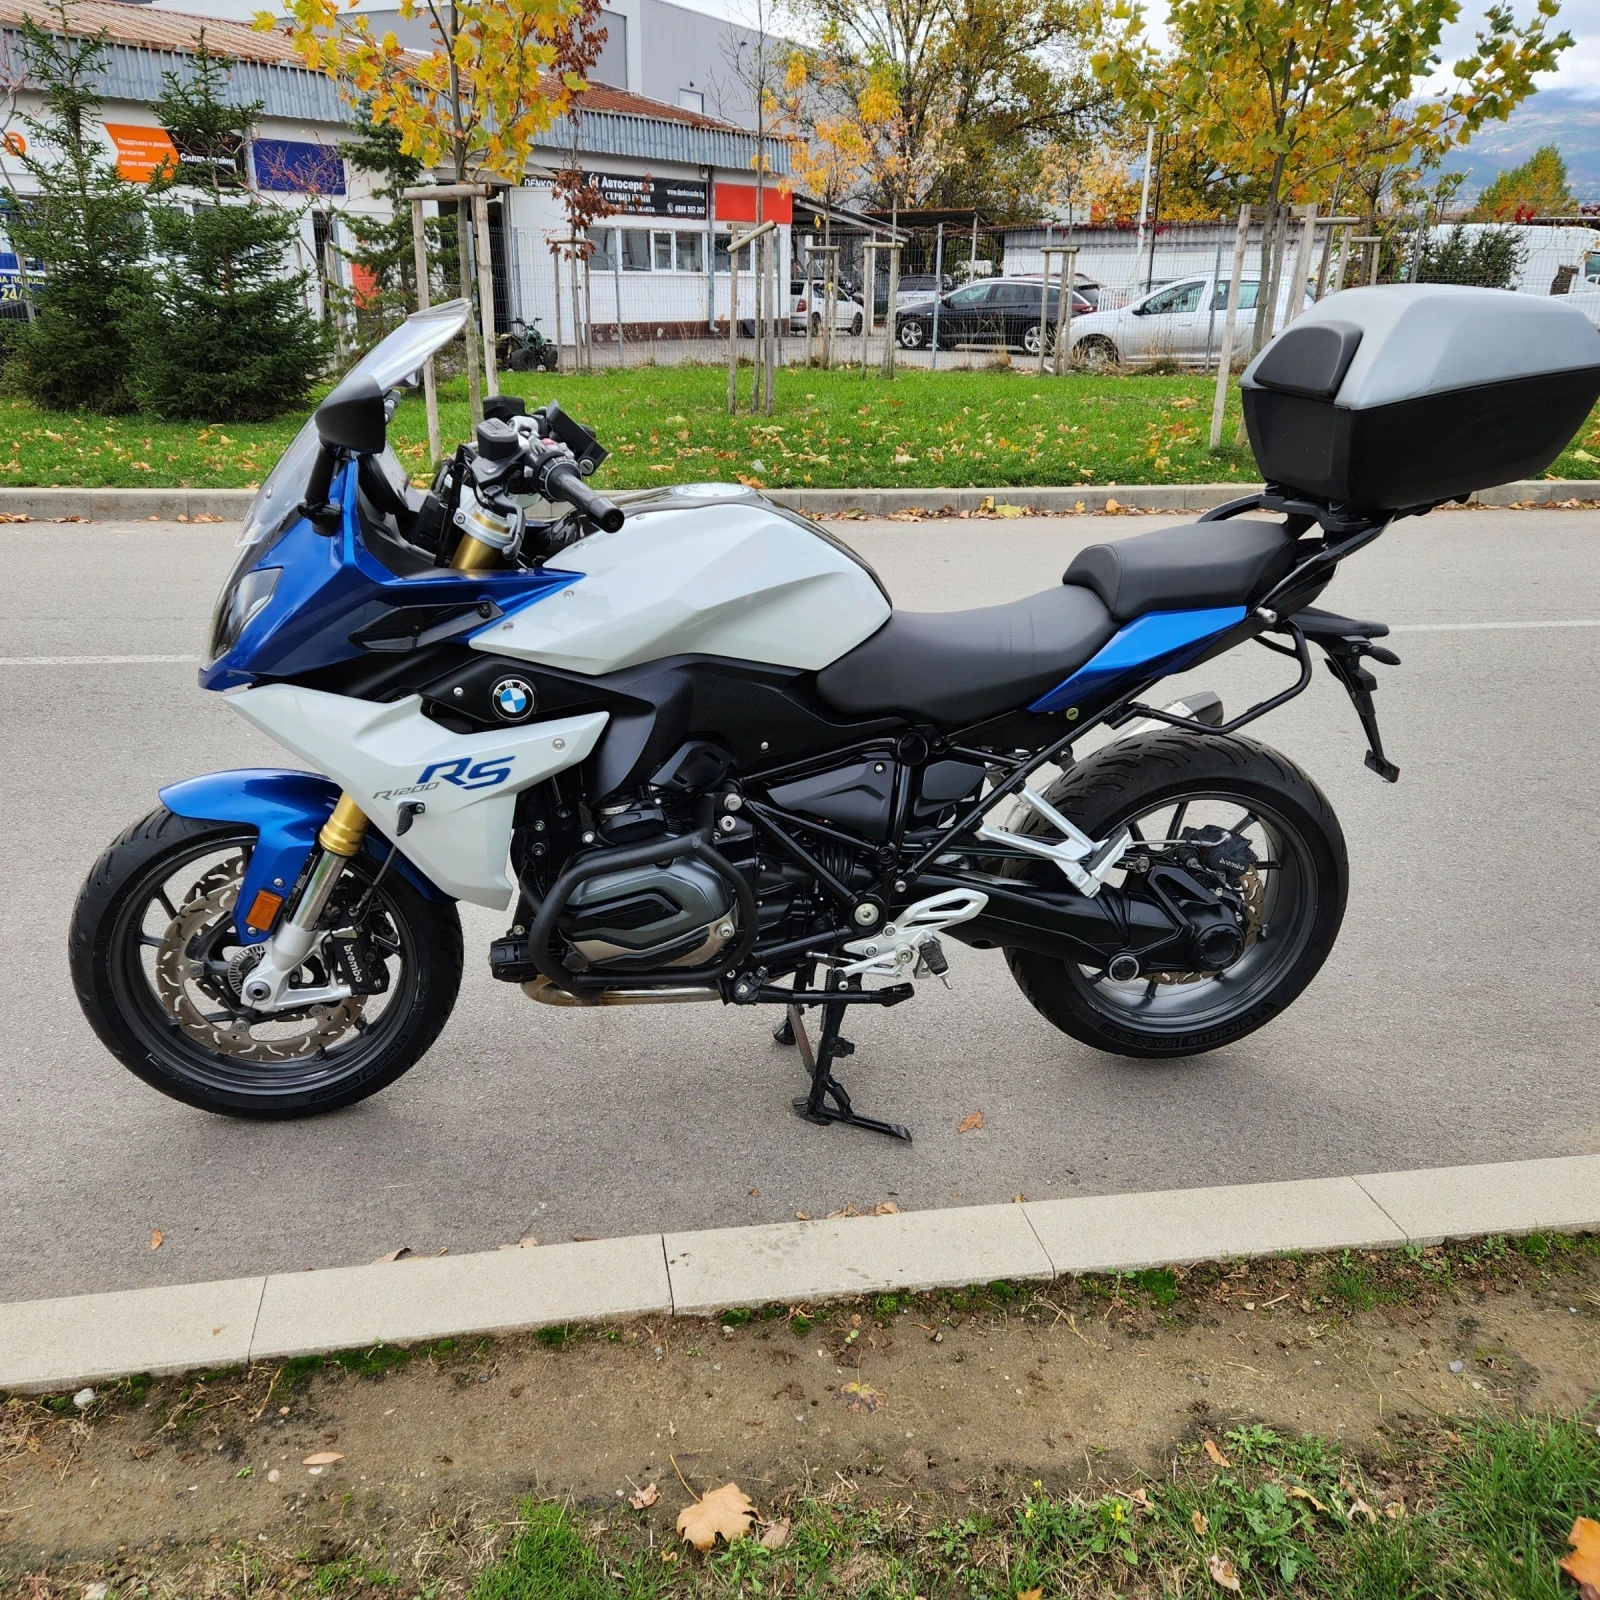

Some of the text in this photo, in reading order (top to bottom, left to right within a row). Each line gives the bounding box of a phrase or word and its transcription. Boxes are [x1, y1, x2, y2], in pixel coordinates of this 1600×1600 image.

[601, 175, 655, 193] Автосервз
[494, 681, 528, 697] BMW
[416, 755, 516, 790] RS
[372, 781, 440, 801] R1200
[1219, 856, 1245, 871] brembo
[343, 944, 363, 983] brembo
[1103, 1015, 1253, 1048] MICHELIN 180/55 ZR 17
